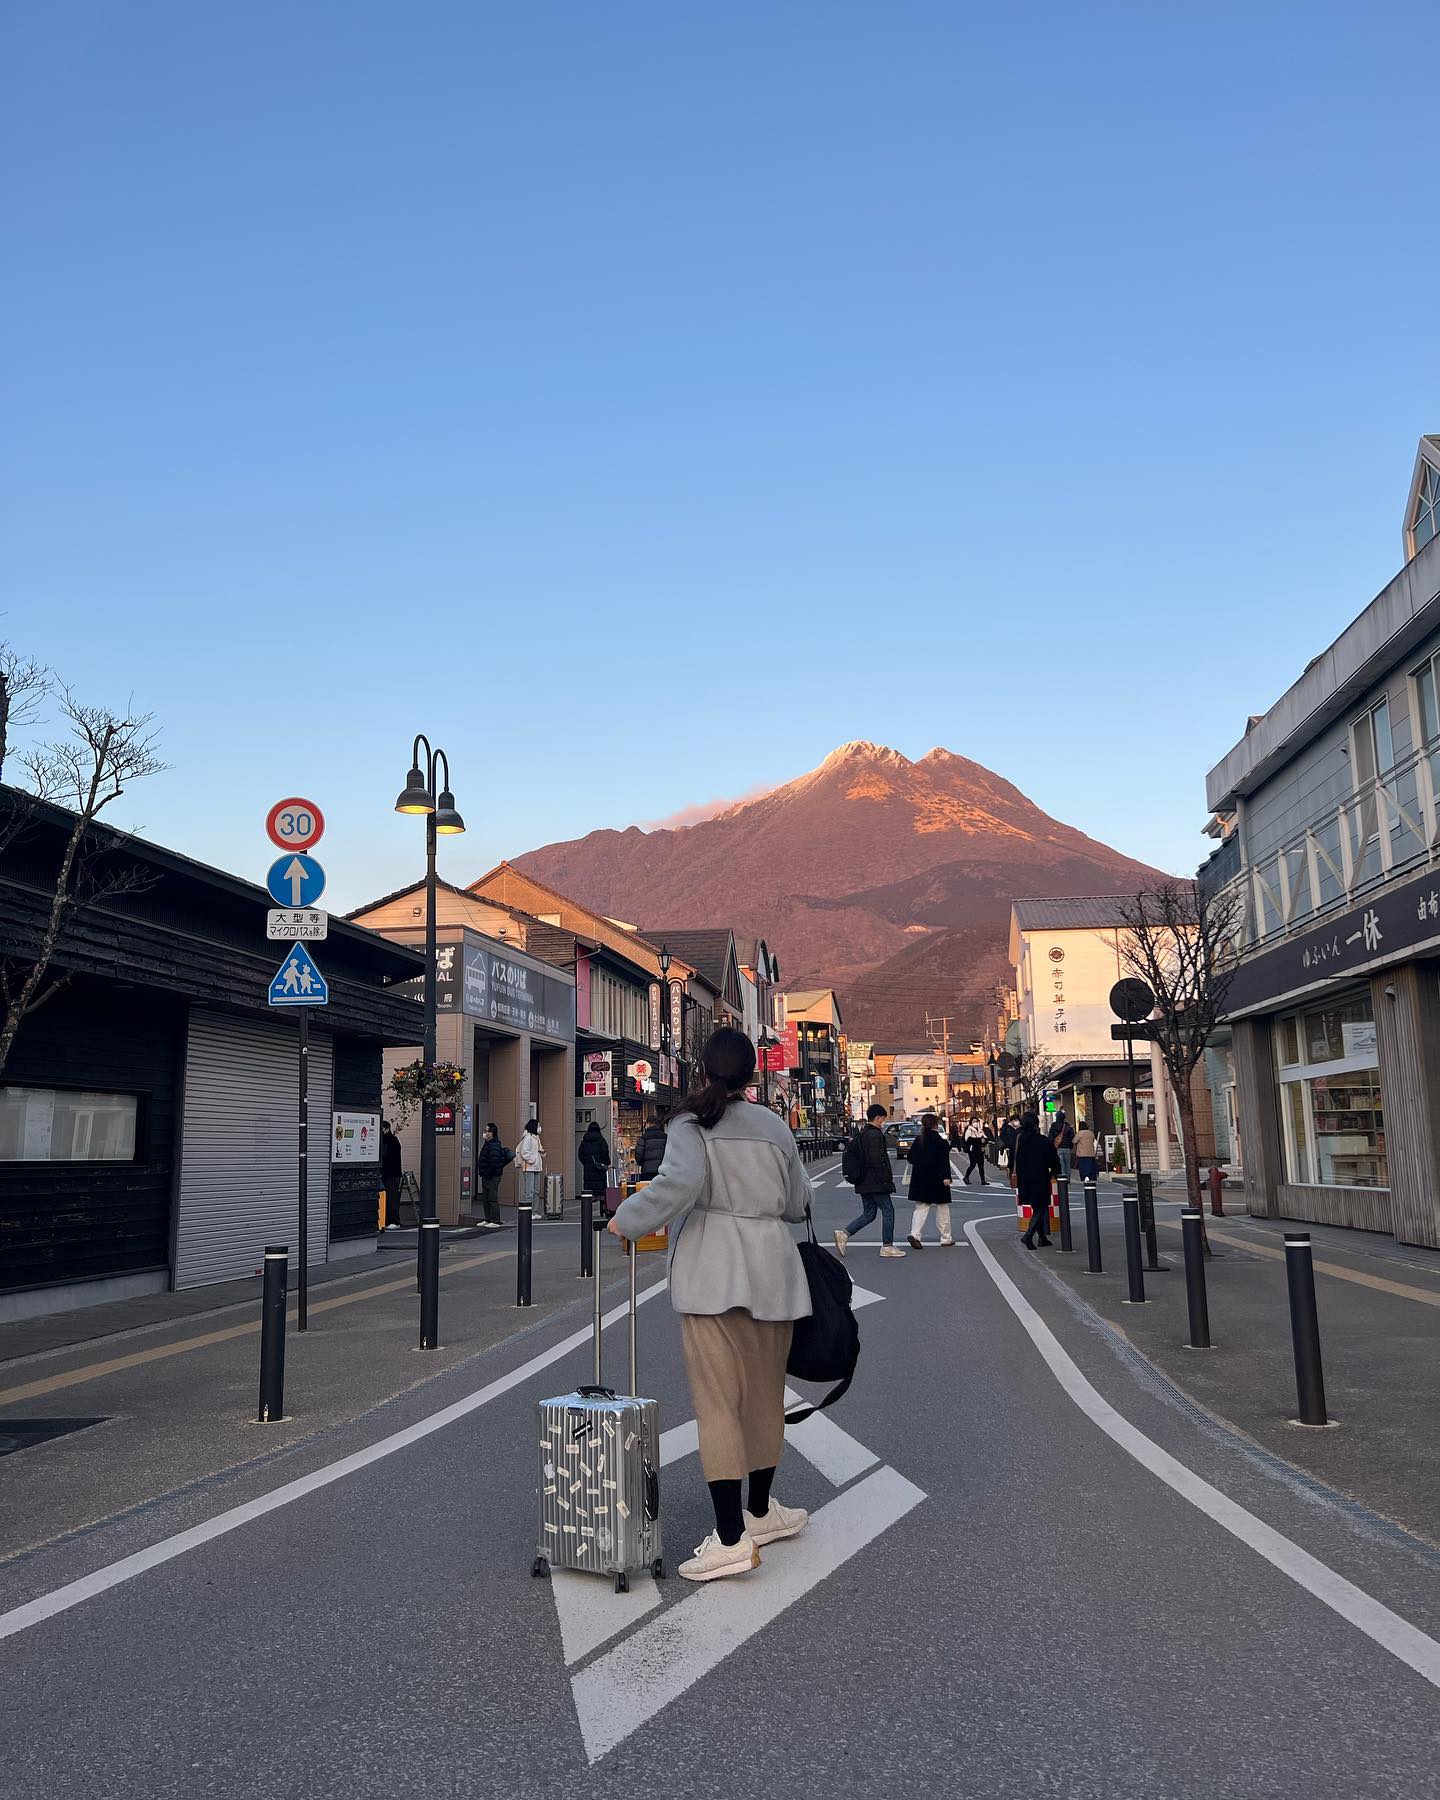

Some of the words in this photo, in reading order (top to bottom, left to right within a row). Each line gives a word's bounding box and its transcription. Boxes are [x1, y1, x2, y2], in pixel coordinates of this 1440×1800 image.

[280, 813, 311, 836] 30
[276, 913, 320, 923] 大型等
[270, 926, 324, 936] マイクロバスを除く
[1302, 935, 1341, 968] ゆふいん
[1345, 908, 1384, 951] 一休
[491, 961, 527, 990] バスのりば
